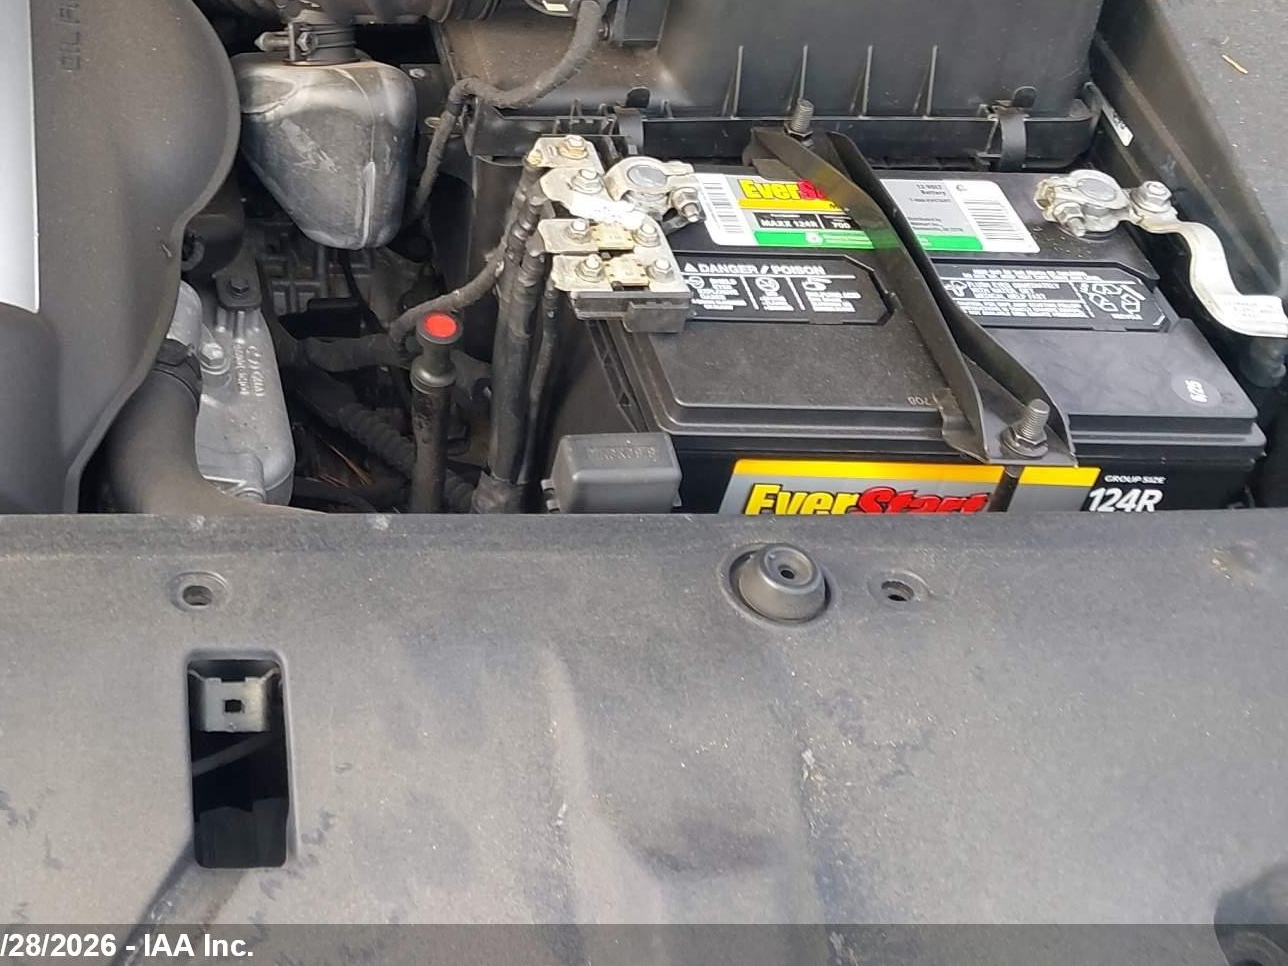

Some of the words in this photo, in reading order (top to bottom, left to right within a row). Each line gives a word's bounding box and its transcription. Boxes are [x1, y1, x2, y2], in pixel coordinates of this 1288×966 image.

[698, 263, 760, 275] DANGER
[770, 265, 826, 275] POISON
[1104, 475, 1142, 483] GROUP
[1142, 476, 1166, 484] SIZE
[745, 484, 991, 514] EverStart
[1087, 487, 1164, 512] 124R
